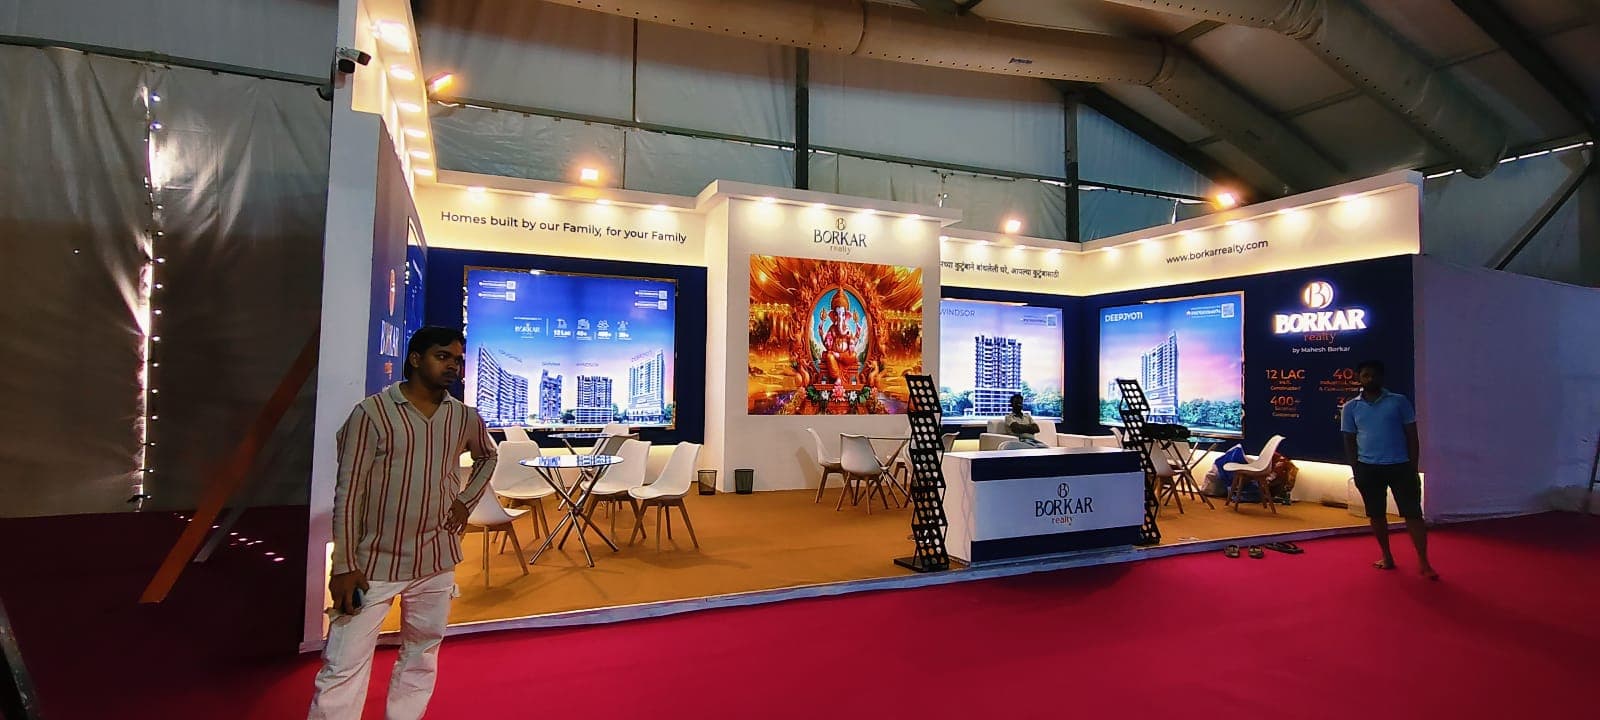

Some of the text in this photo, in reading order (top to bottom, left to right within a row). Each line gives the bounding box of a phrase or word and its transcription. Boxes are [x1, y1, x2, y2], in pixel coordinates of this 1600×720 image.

[440, 211, 687, 244] Homes built by our Family, for your Family
[813, 229, 868, 248] BORKAR
[830, 245, 852, 255] realty
[1166, 239, 1269, 264] www.borkarrealty.com
[1104, 311, 1143, 323] DEEPJYOTI
[1273, 308, 1367, 334] BORKAR
[1304, 332, 1336, 344] realty
[1265, 369, 1306, 379] 12 LAC
[1035, 497, 1093, 517] BORKAR
[1052, 515, 1073, 526] realty
